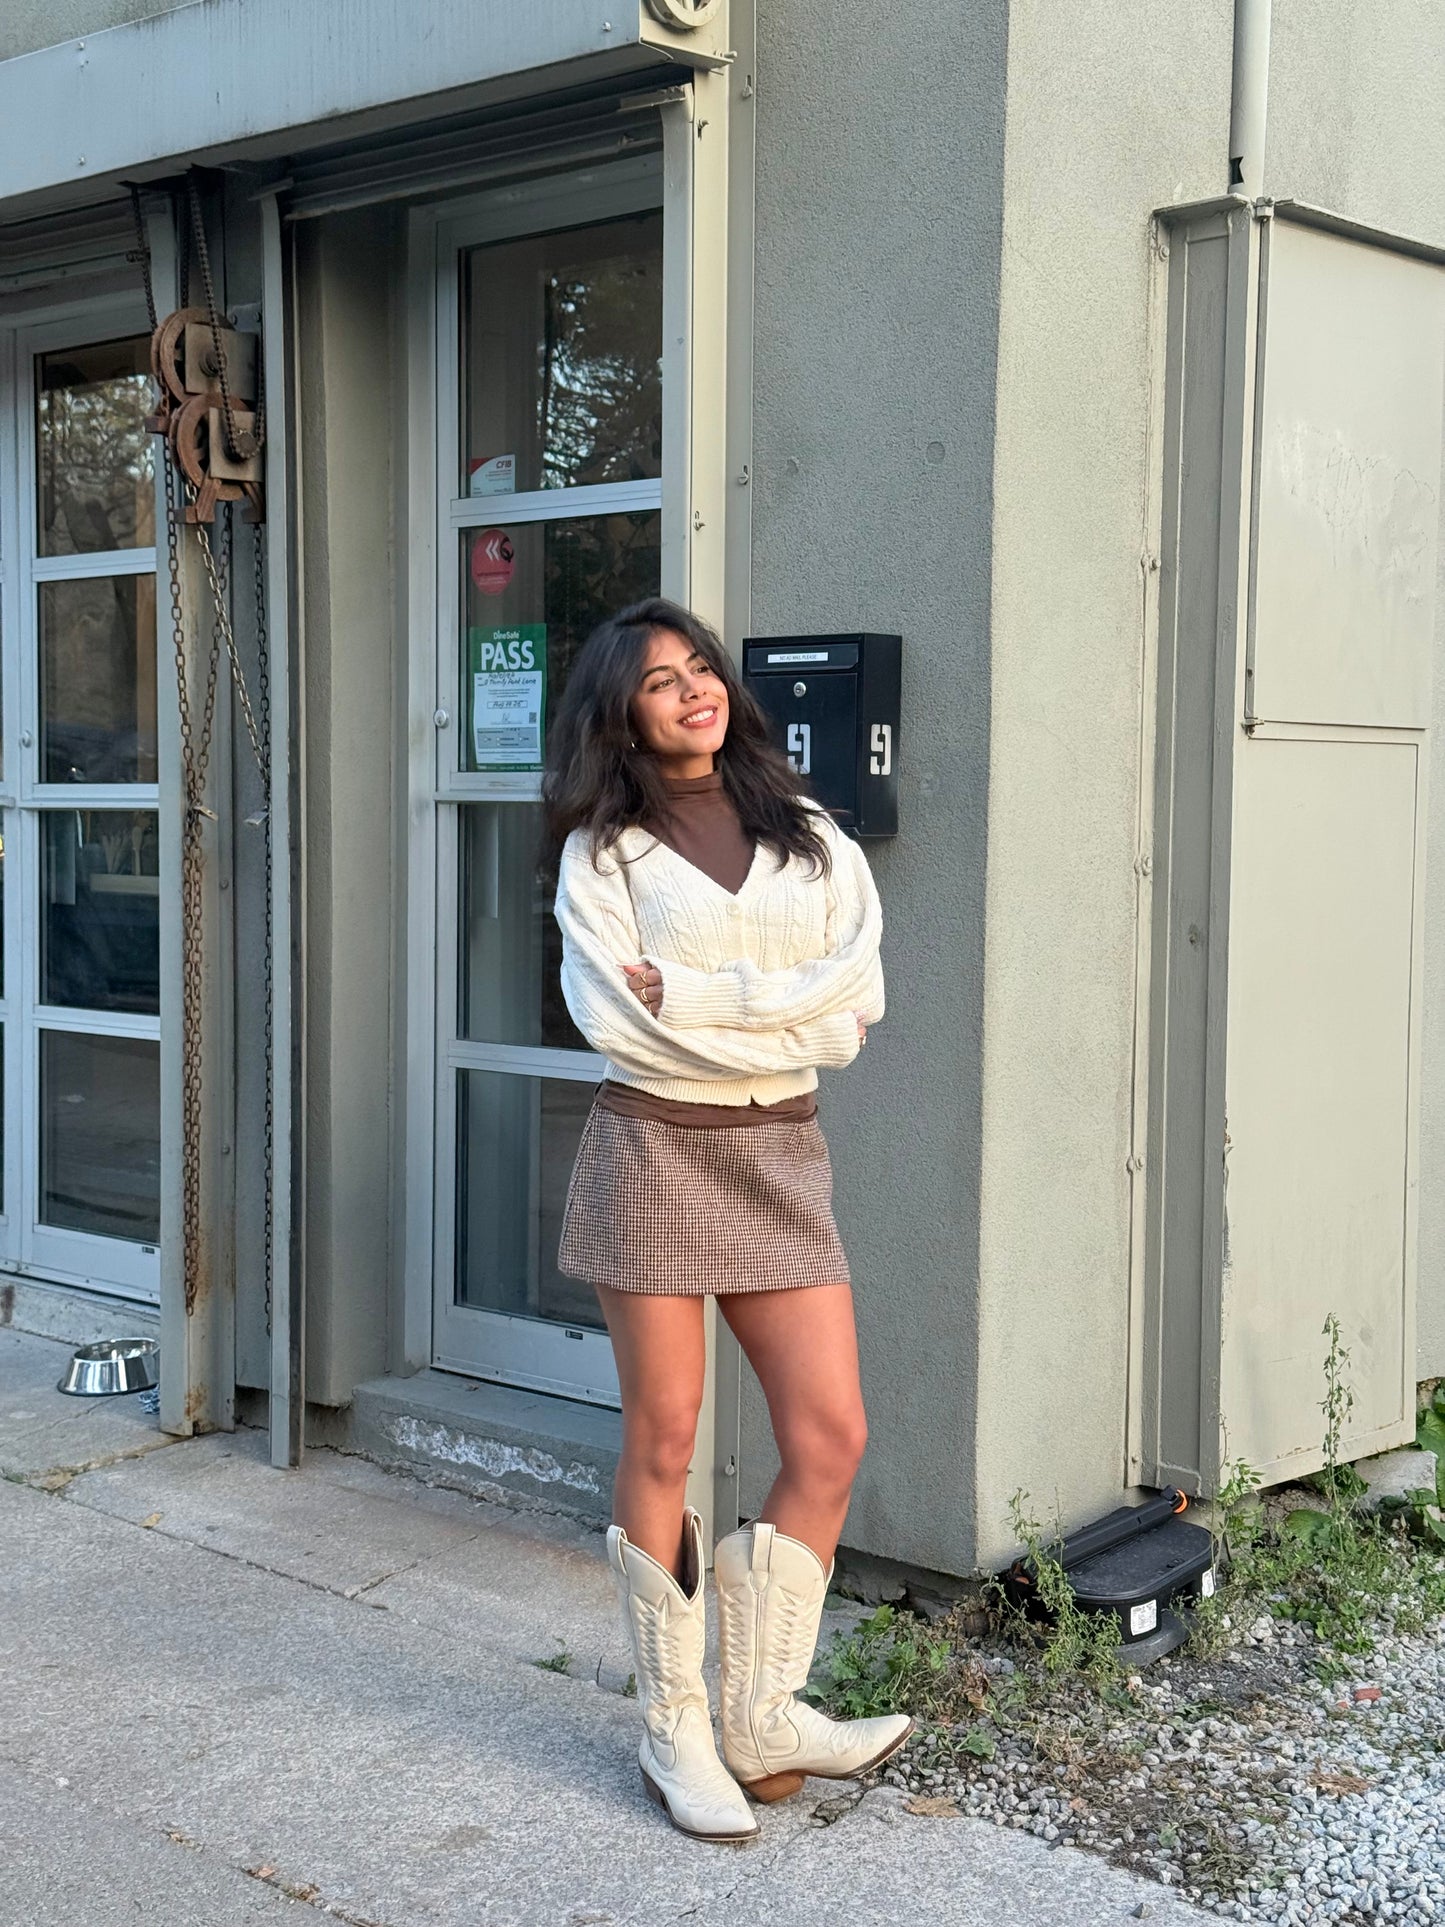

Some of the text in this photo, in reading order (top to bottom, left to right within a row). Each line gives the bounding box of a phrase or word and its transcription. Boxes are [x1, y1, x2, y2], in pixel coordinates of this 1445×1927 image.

[496, 460, 512, 469] CFIB
[493, 630, 520, 640] DineSafe
[481, 640, 535, 671] PASS
[787, 723, 811, 775] 9
[870, 723, 892, 776] 9
